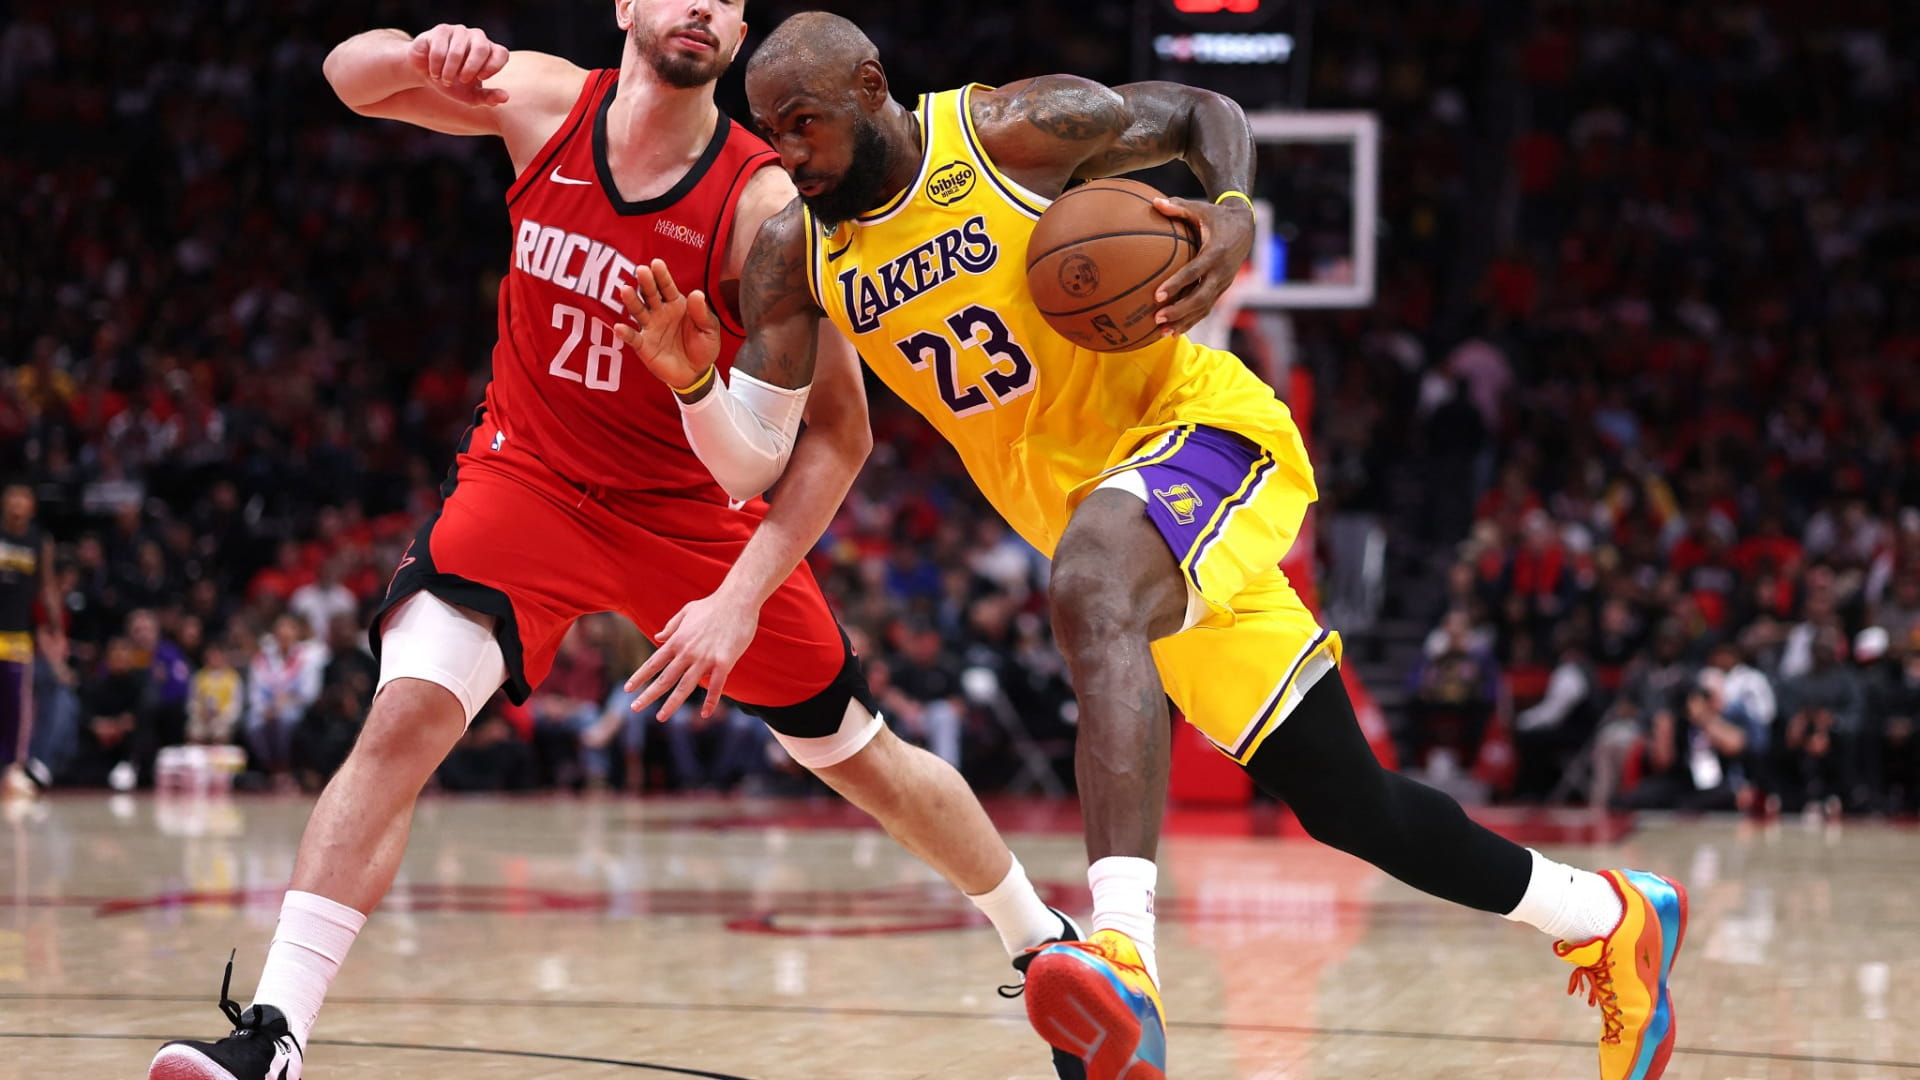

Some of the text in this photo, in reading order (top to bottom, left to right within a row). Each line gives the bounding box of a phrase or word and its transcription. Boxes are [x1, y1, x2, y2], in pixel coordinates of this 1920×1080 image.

[930, 169, 972, 195] bibigo
[515, 218, 645, 325] ROCKE
[654, 225, 705, 249] HERMANN
[656, 218, 705, 243] MEMORIAL
[837, 215, 999, 334] LAKERS
[549, 302, 625, 392] 28
[896, 303, 1038, 419] 23
